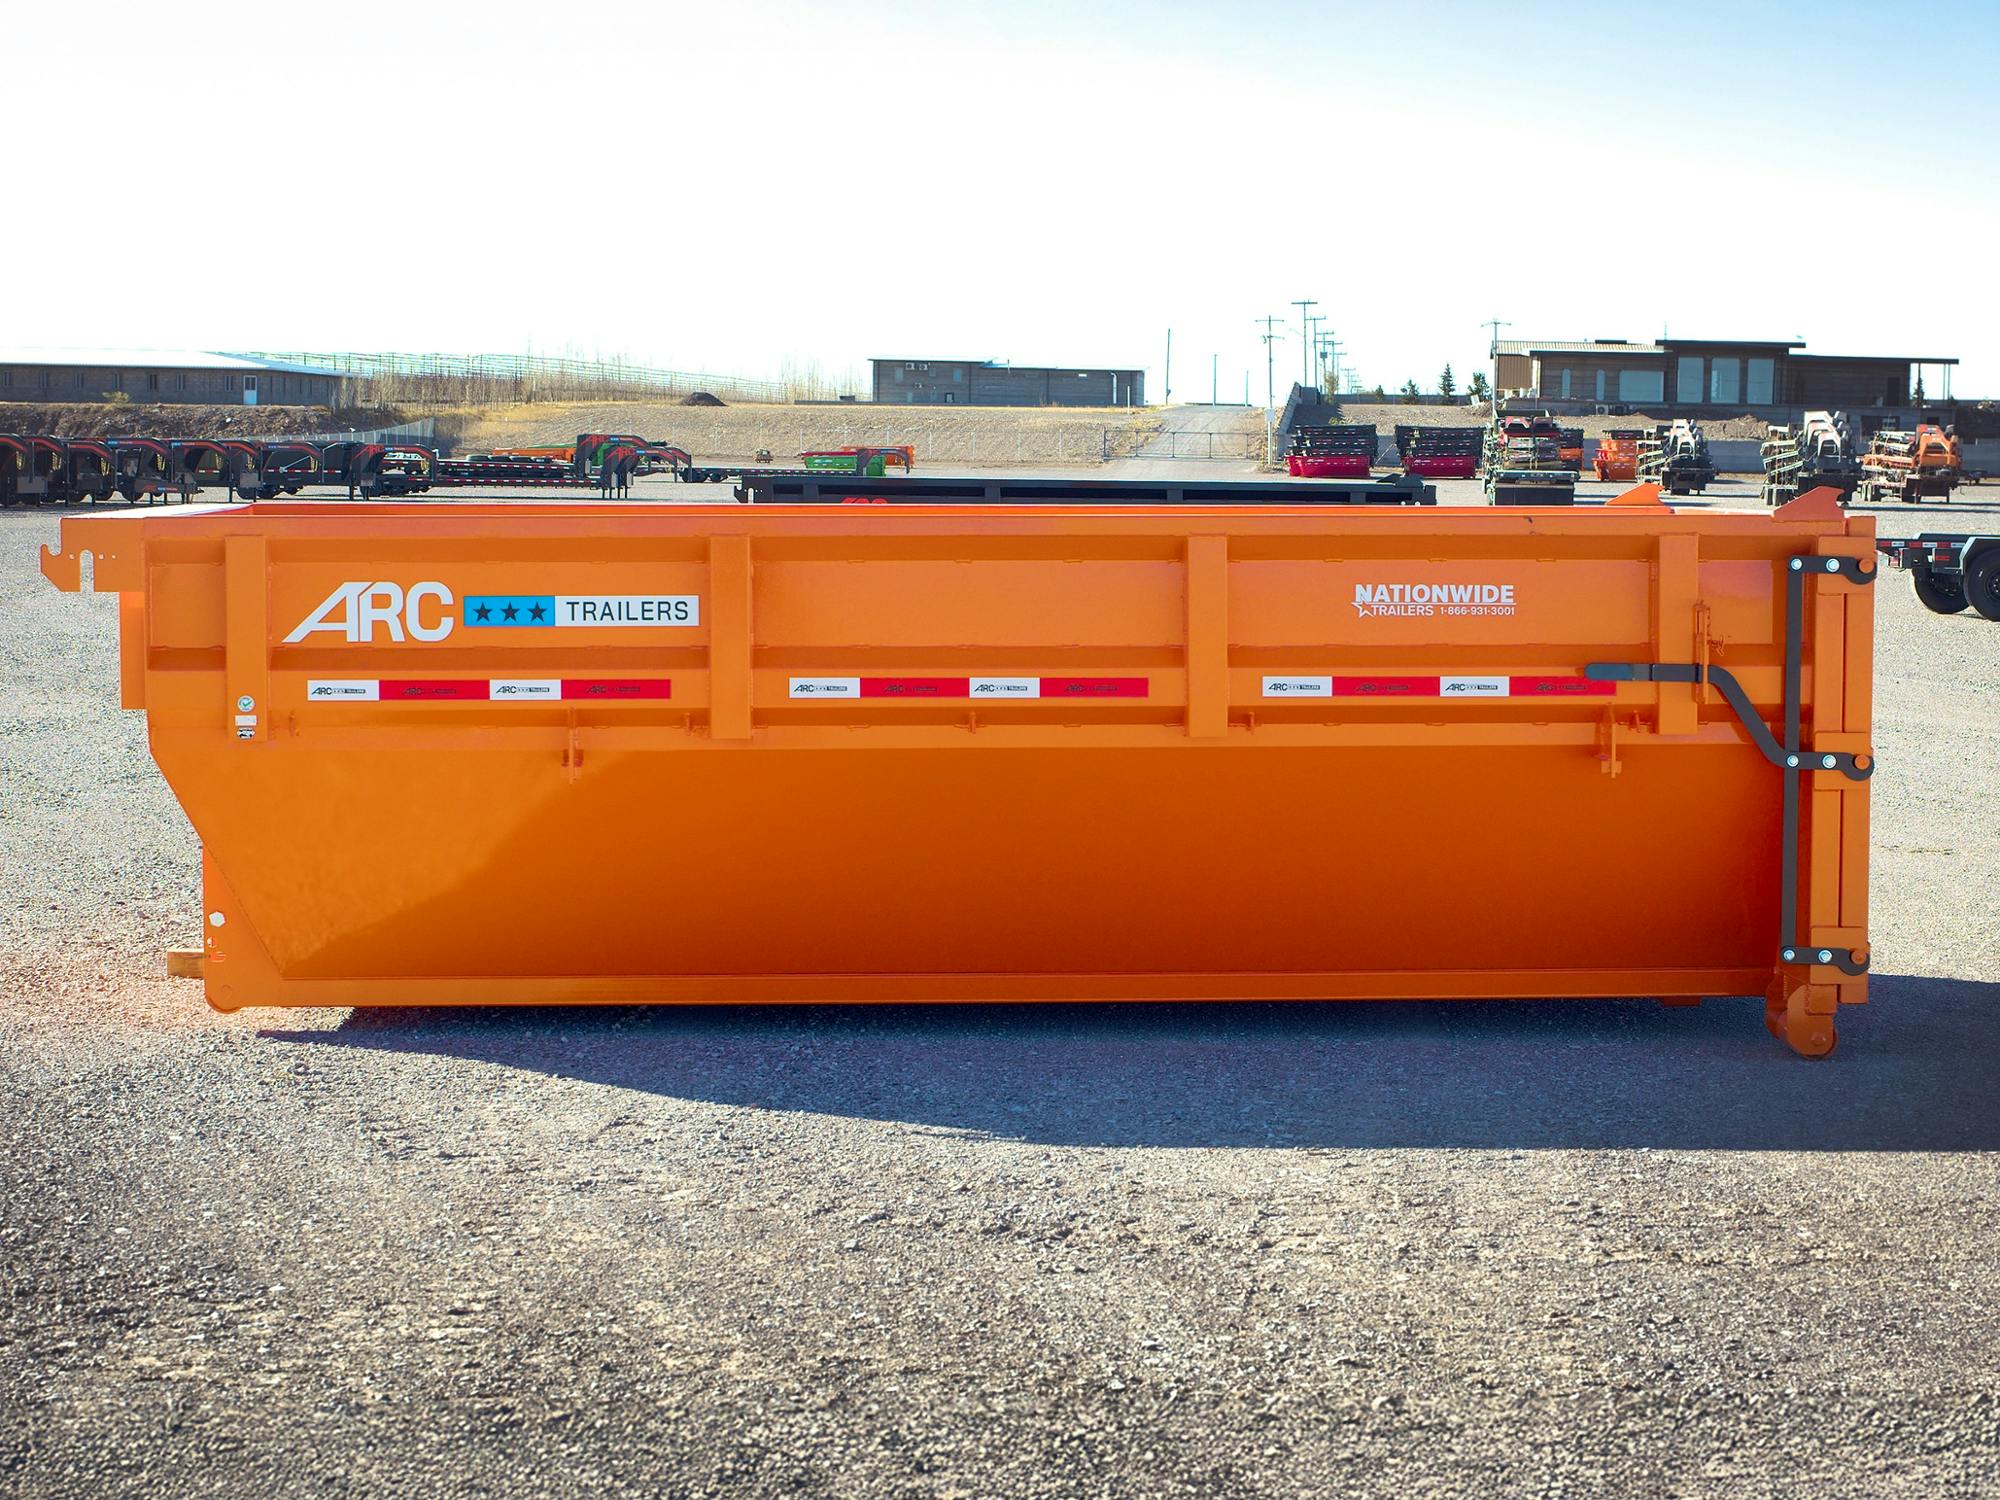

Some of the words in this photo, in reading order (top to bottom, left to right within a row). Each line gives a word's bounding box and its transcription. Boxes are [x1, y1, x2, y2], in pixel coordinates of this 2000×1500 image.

[1355, 584, 1514, 603] NATIONWIDE
[281, 581, 454, 643] ARC
[566, 601, 689, 621] TRAILERS
[1371, 605, 1434, 616] TRAILERS
[1440, 606, 1515, 616] 1-866-931-3001
[311, 686, 333, 695] ARC
[496, 685, 517, 694] ARC
[794, 684, 814, 693] ARC
[974, 684, 995, 693] ARC
[1268, 682, 1288, 691] ARC
[1445, 683, 1466, 692] ARC
